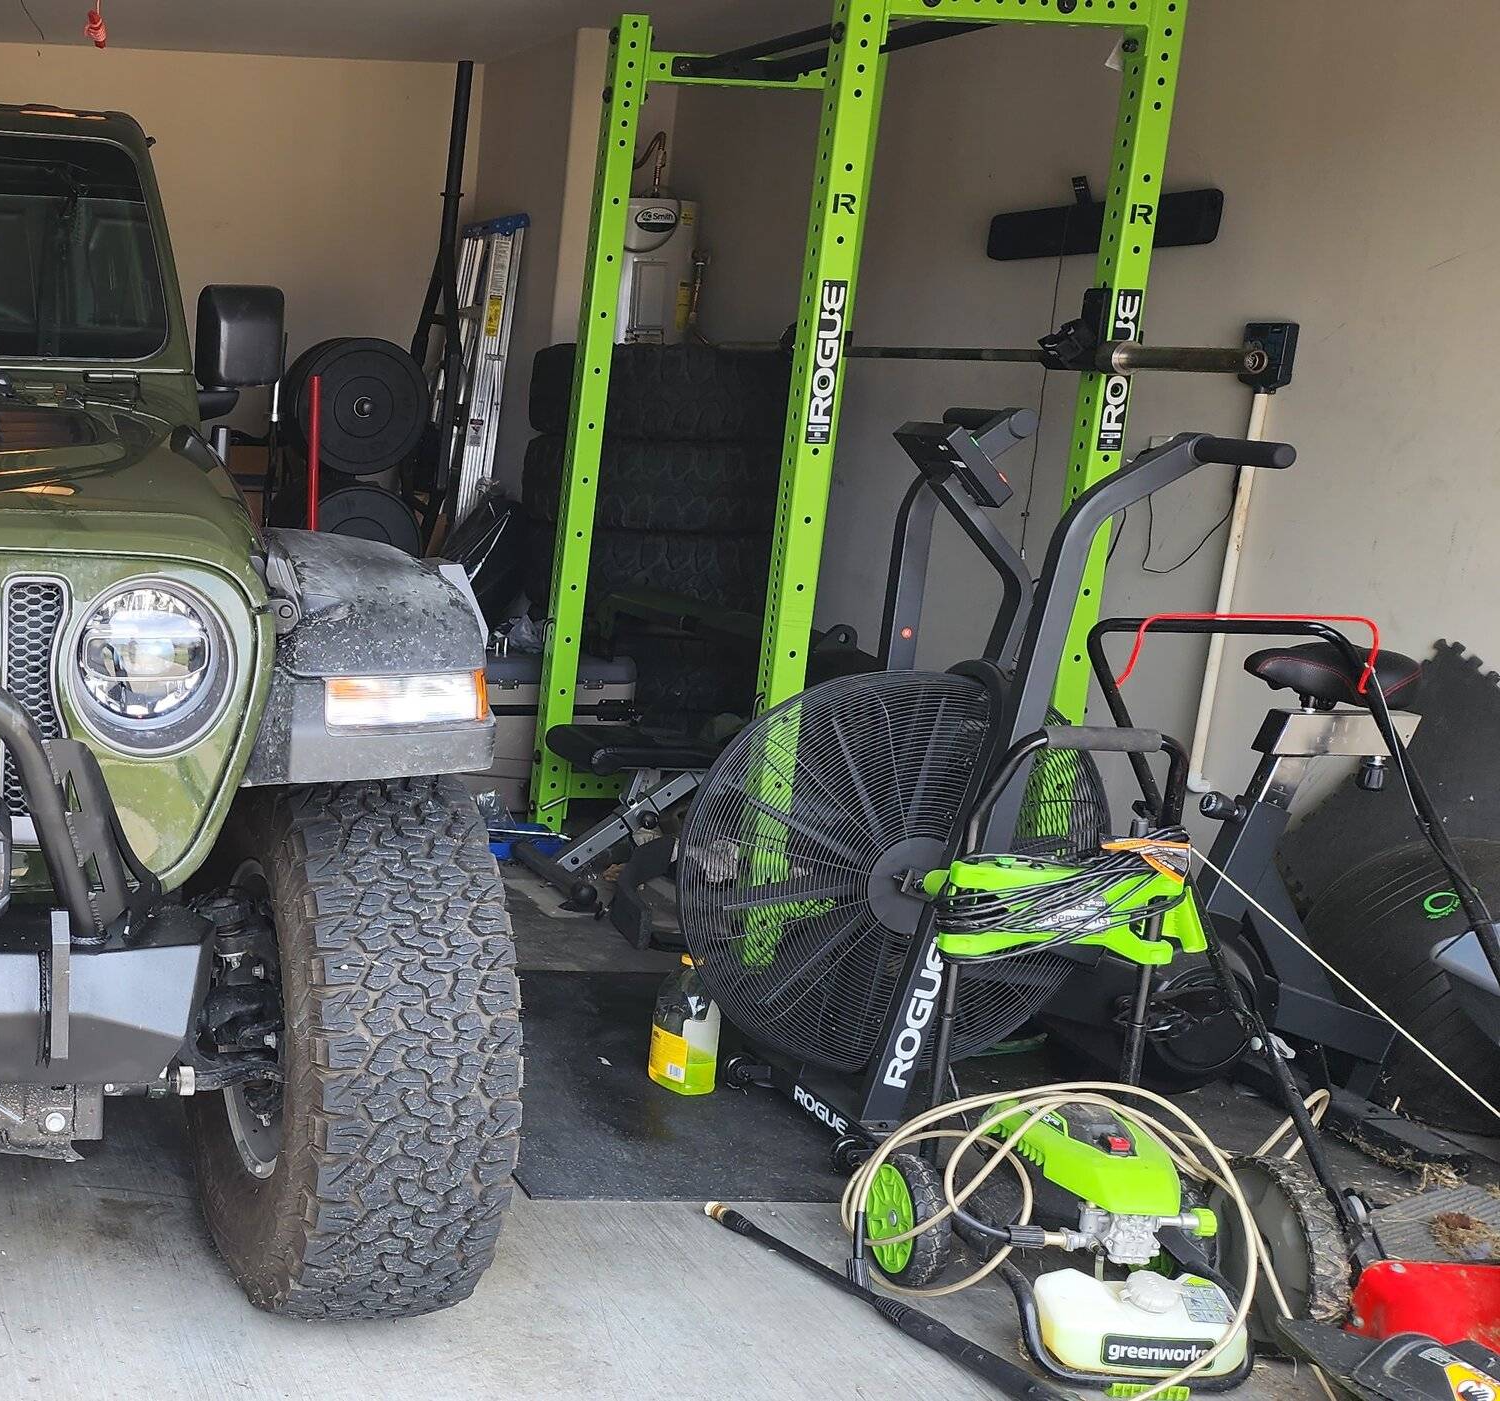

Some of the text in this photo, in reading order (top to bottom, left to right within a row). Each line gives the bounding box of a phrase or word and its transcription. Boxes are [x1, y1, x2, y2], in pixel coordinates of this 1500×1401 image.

[808, 284, 847, 424] ROGUE
[1101, 294, 1140, 431] ROUE
[883, 942, 944, 1089] ROGUE
[794, 1084, 849, 1136] ROGUE
